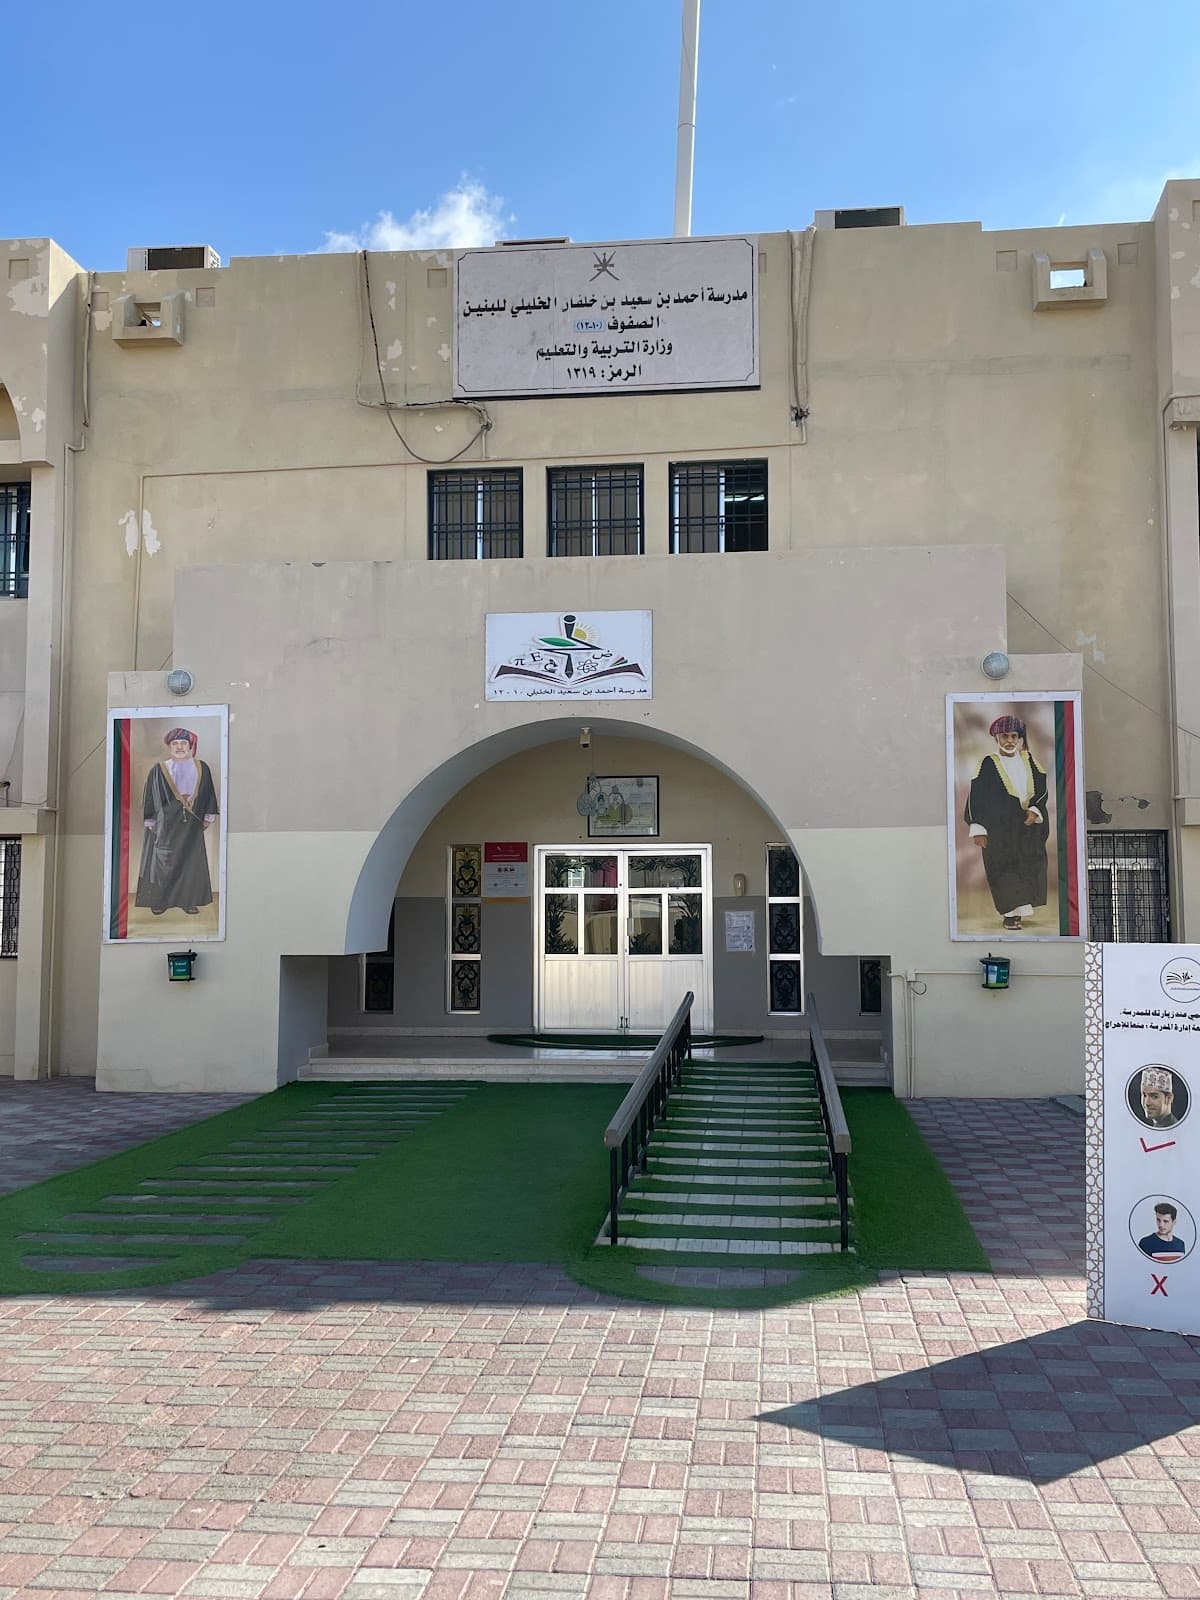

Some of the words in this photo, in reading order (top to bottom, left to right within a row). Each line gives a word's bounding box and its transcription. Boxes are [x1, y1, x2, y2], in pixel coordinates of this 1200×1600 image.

[601, 295, 616, 312] بن
[621, 295, 652, 309] سعيد
[657, 292, 670, 309] بن
[673, 287, 704, 304] أحمد
[708, 287, 748, 304] مدرسة
[463, 298, 507, 317] للبنين
[511, 296, 556, 318] الخليلي
[607, 315, 659, 333] الصفوف
[536, 343, 588, 360] والتعليم
[592, 340, 640, 358] التربية
[642, 338, 673, 355] وزارة
[595, 686, 615, 694] أحمد
[618, 687, 647, 695] مدرسة
